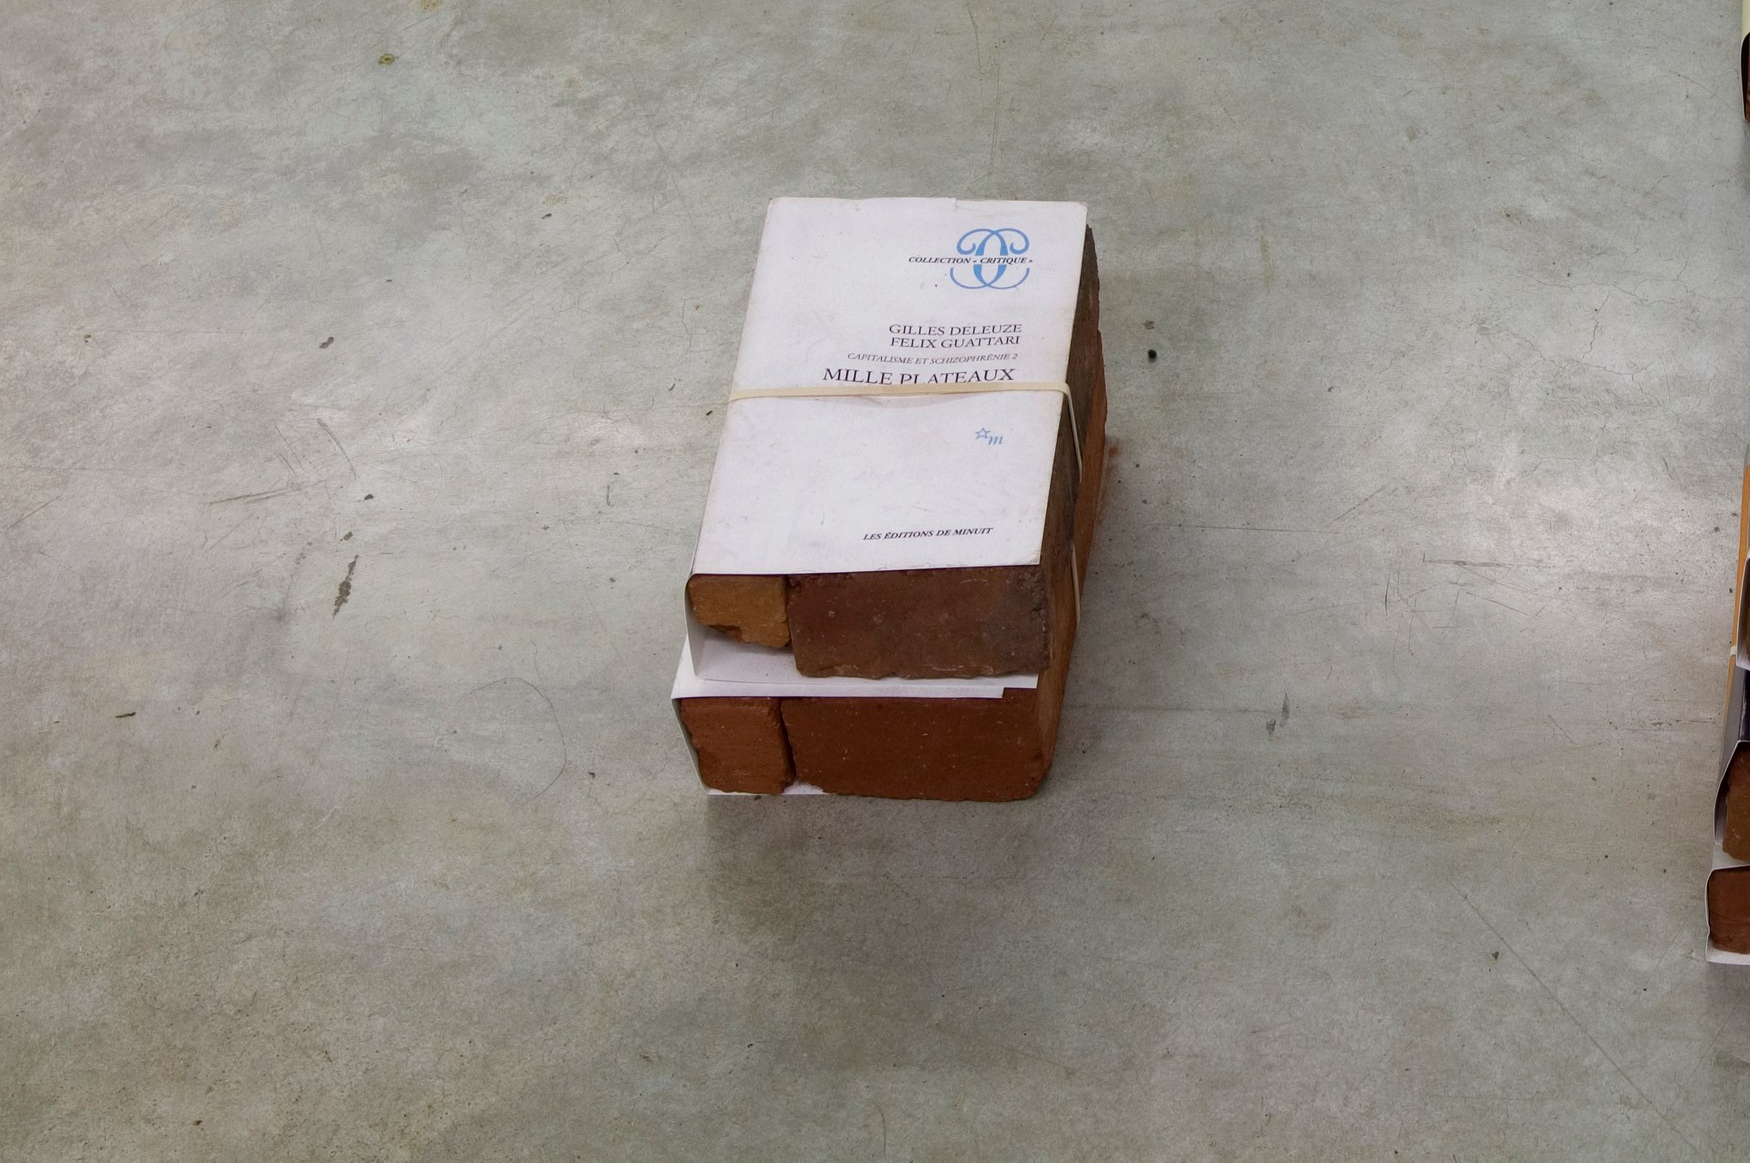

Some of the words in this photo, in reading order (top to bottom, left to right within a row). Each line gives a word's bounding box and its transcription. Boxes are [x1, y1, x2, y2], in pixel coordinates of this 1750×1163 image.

[908, 256, 971, 264] COLLECTION
[889, 324, 945, 336] GILLES
[950, 323, 1023, 336] DELEUZE
[940, 336, 1021, 349] GUATTARI
[847, 352, 914, 364] CAPITALISME
[915, 357, 929, 365] ET
[929, 353, 1011, 365] SCHIZOPHRÉNIE
[822, 368, 893, 385] MILLE
[899, 368, 1016, 385] PLATEAUX
[883, 529, 934, 540] ÉDITIONS
[936, 529, 952, 537] DE
[952, 527, 994, 536] MINUIT
